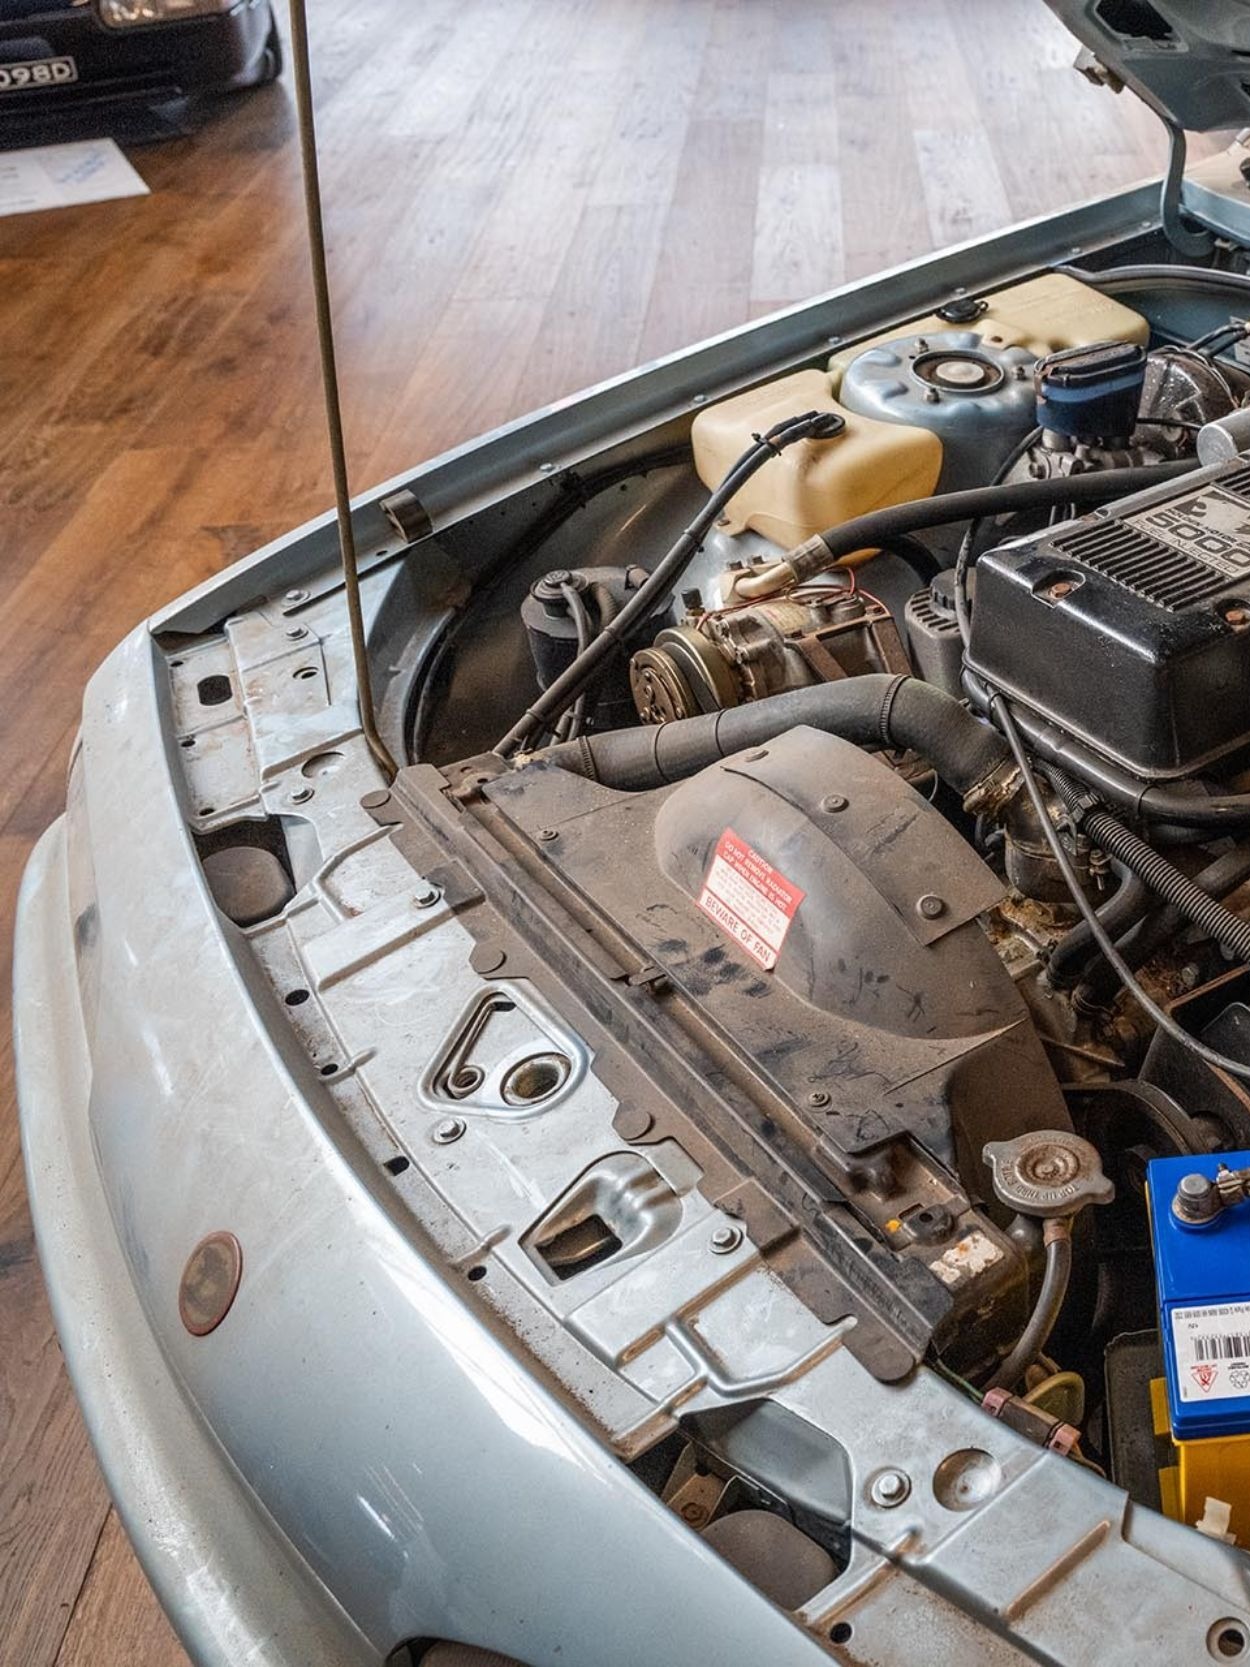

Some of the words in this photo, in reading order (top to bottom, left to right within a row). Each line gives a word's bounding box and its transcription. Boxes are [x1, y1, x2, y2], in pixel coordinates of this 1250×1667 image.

[1131, 518, 1168, 537] FUEL
[1167, 537, 1239, 574] INJECTED
[747, 848, 774, 875] CAUTION
[704, 895, 740, 933] BEWARE
[739, 927, 753, 945] OF
[752, 939, 771, 962] FAN
